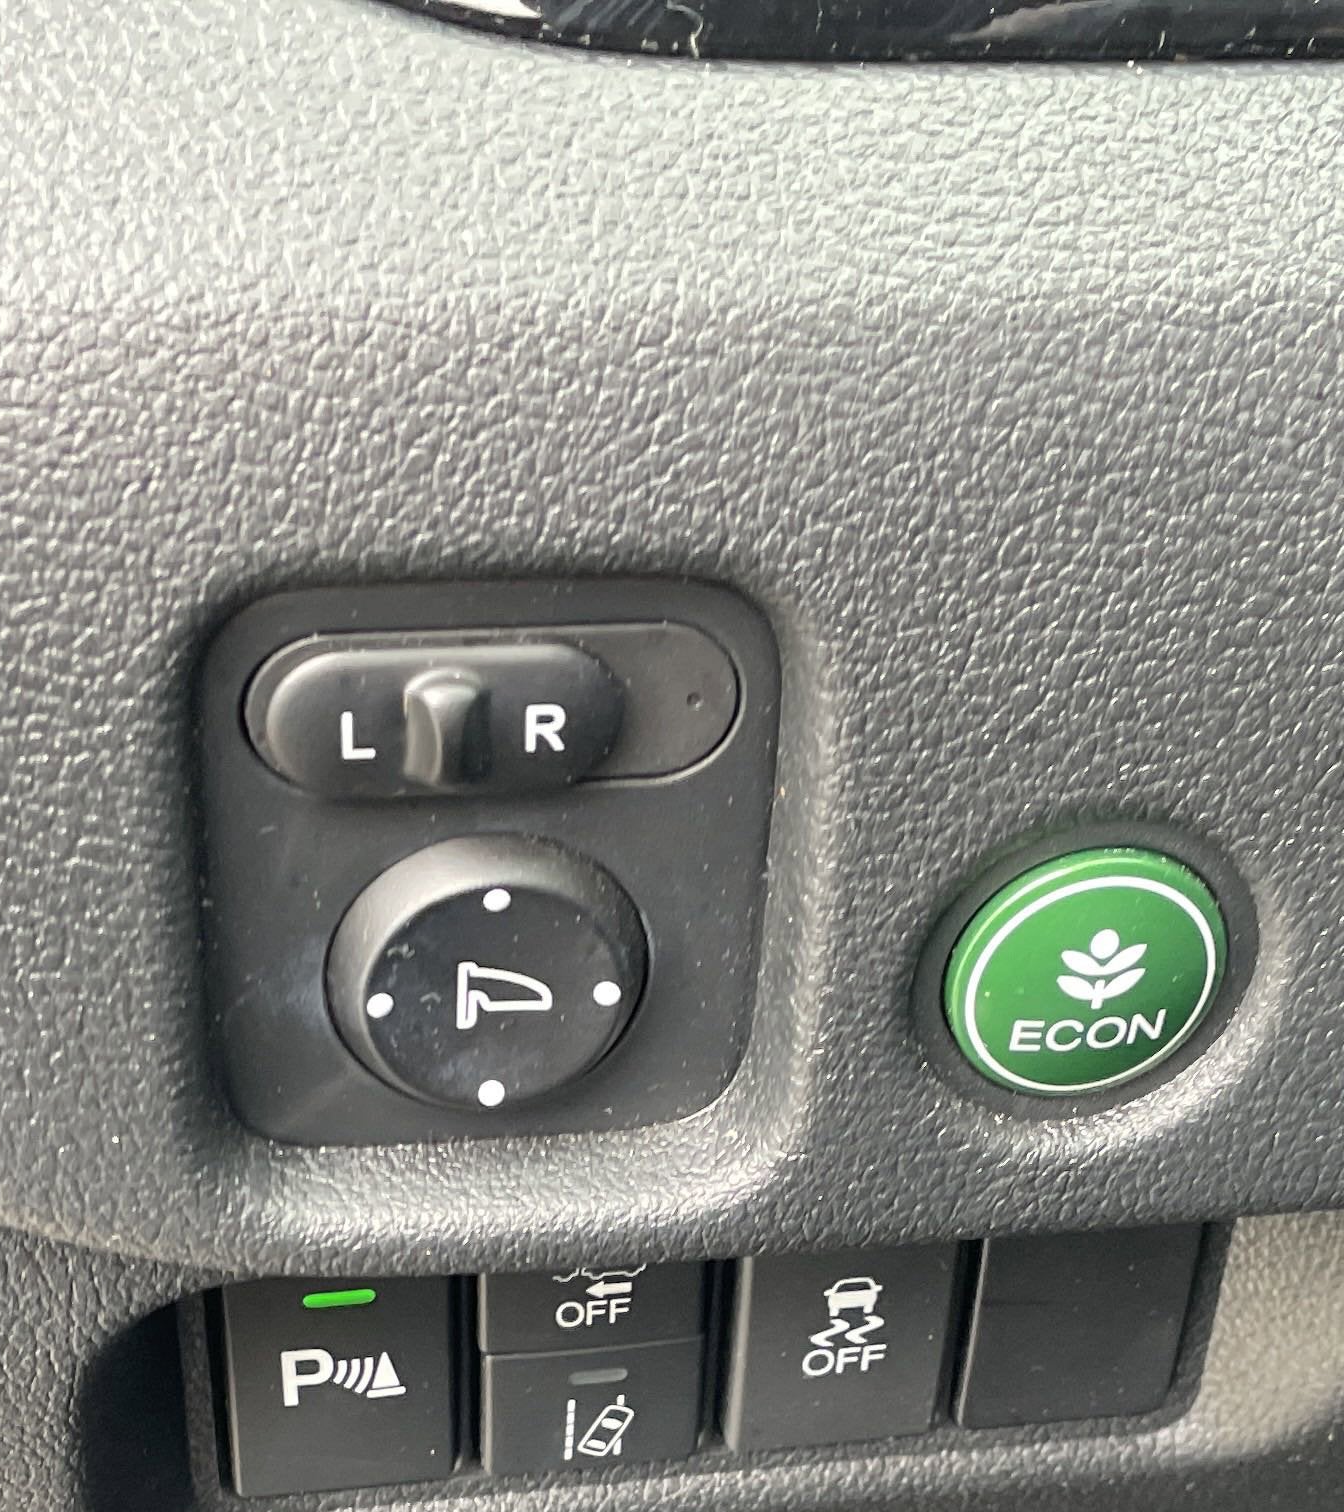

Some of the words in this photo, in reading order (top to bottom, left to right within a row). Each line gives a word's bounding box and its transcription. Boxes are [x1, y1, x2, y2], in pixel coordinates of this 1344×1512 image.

[340, 711, 376, 760] L
[524, 703, 566, 753] R
[1008, 1008, 1167, 1052] ECON
[556, 1298, 631, 1328] OFF
[801, 1343, 887, 1377] OFF
